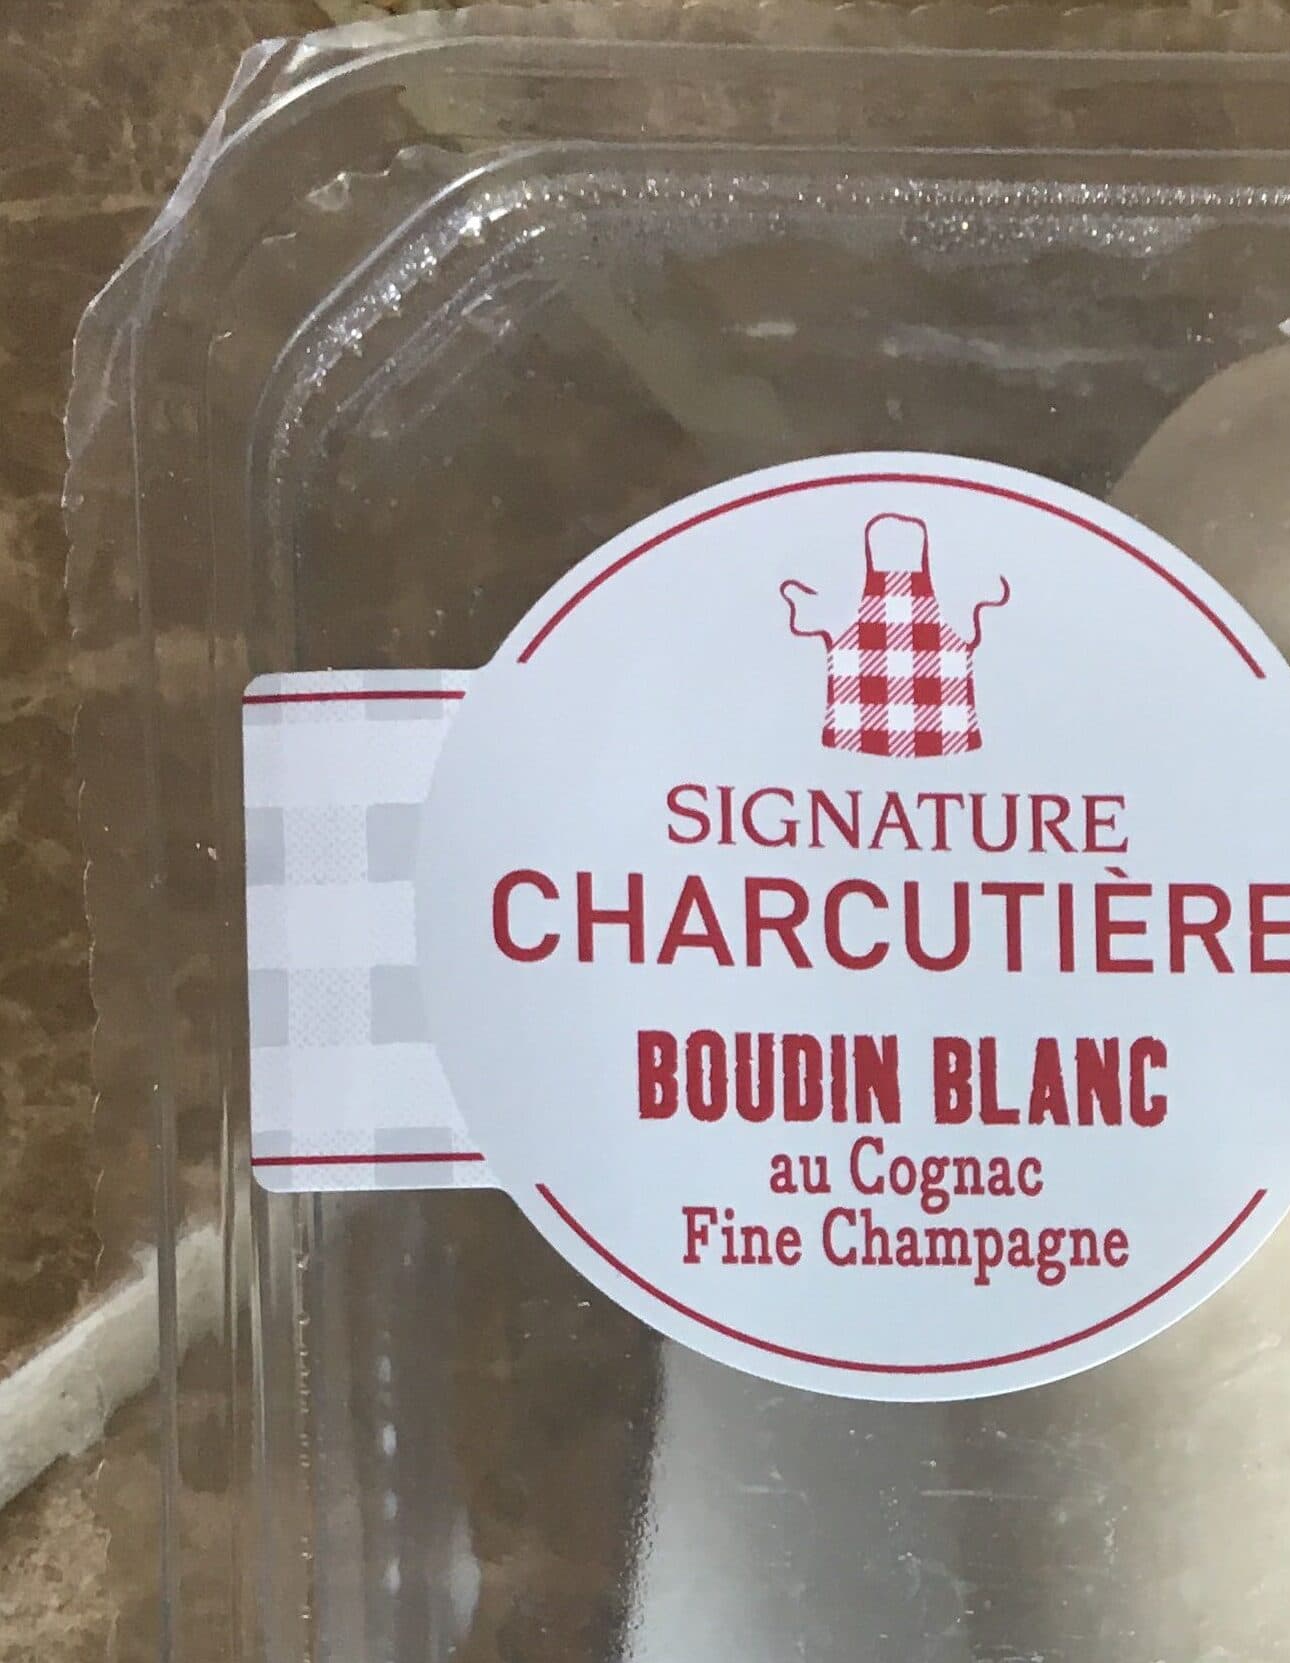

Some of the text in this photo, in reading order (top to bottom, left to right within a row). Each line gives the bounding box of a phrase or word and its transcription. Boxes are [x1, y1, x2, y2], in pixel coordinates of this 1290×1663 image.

[665, 783, 1130, 854] SIGNATURE
[636, 1029, 1170, 1128] BOUDIN BLANC
[769, 1135, 1044, 1215] au Cognac
[682, 1206, 1131, 1286] Fine Champagne
